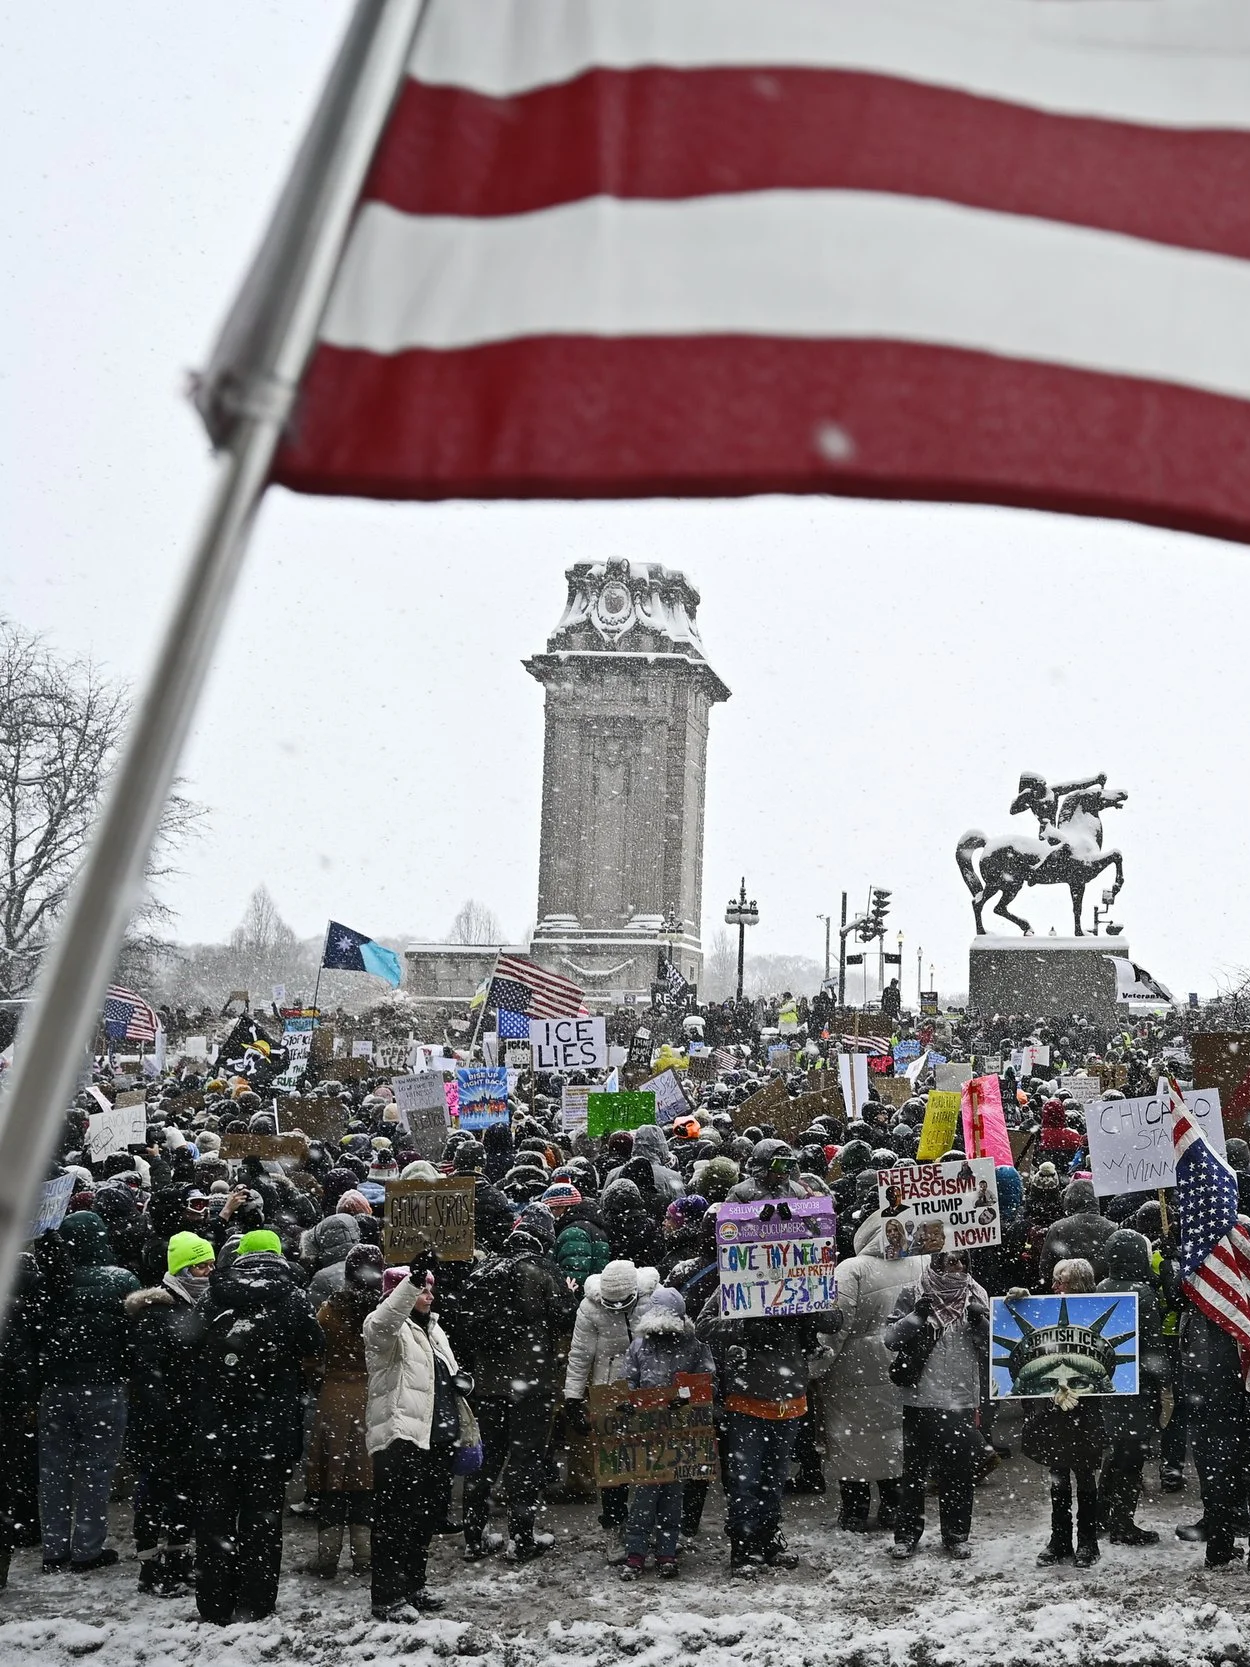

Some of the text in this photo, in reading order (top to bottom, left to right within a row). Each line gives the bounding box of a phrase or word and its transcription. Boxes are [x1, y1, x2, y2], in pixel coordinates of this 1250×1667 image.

[545, 1020, 593, 1046] ICE
[537, 1042, 597, 1068] LIES
[463, 1080, 484, 1088] FIGHT
[1100, 1098, 1211, 1134] CHICAO
[1135, 1123, 1208, 1150] STAS
[878, 1164, 944, 1187] REFUSE
[900, 1176, 977, 1200] FASCISM!
[391, 1194, 470, 1228] GEORGE SOROS
[912, 1198, 963, 1216] TRUMP
[949, 1210, 977, 1225] OUT
[761, 1222, 806, 1235] CUCUMBERS
[954, 1227, 996, 1247] NOW!
[719, 1244, 759, 1272] LOVE
[761, 1241, 790, 1269] THY
[787, 1268, 806, 1278] ALEX
[721, 1279, 769, 1312] MATT
[765, 1303, 804, 1316] RENEE
[1027, 1330, 1098, 1348] ABOLISH ICE
